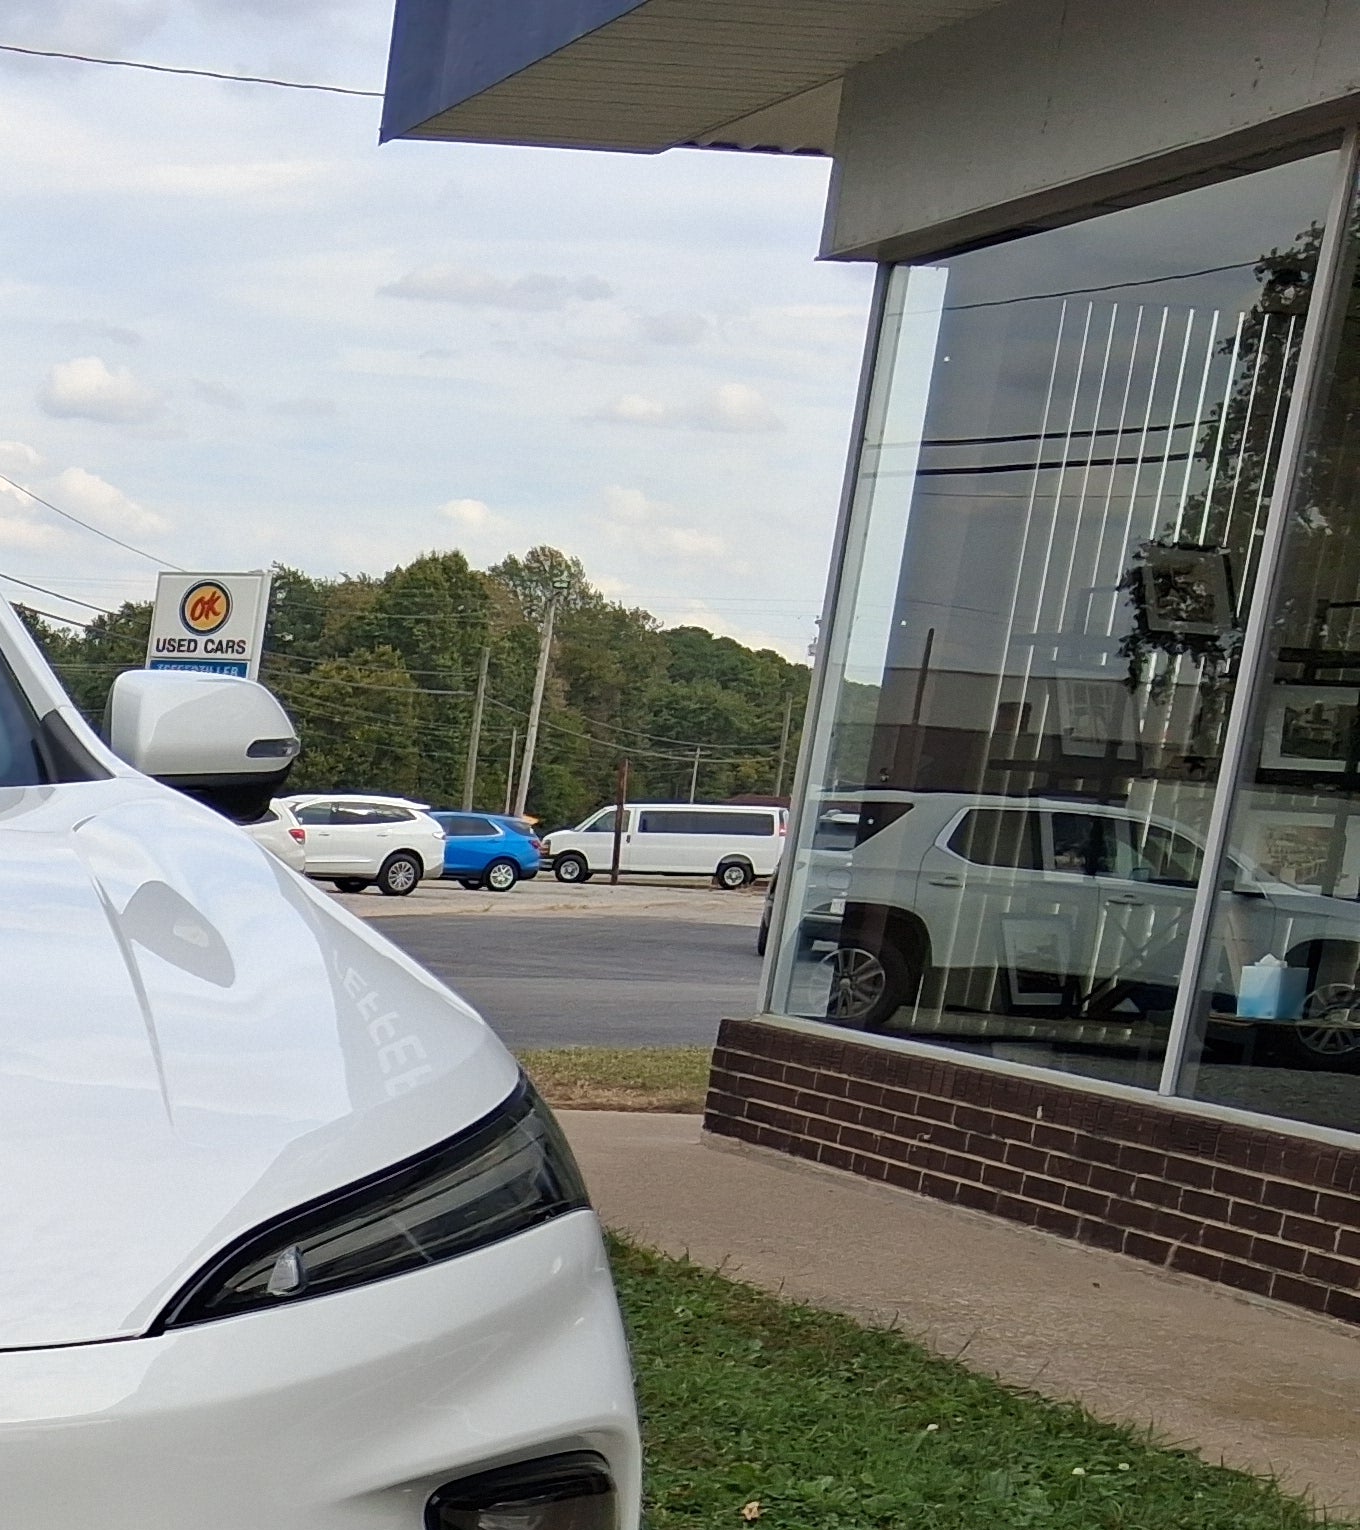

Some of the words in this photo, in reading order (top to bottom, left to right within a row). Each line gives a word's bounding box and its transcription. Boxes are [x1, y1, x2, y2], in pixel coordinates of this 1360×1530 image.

[190, 590, 222, 621] OK
[156, 638, 198, 653] USED
[204, 639, 246, 655] CARS
